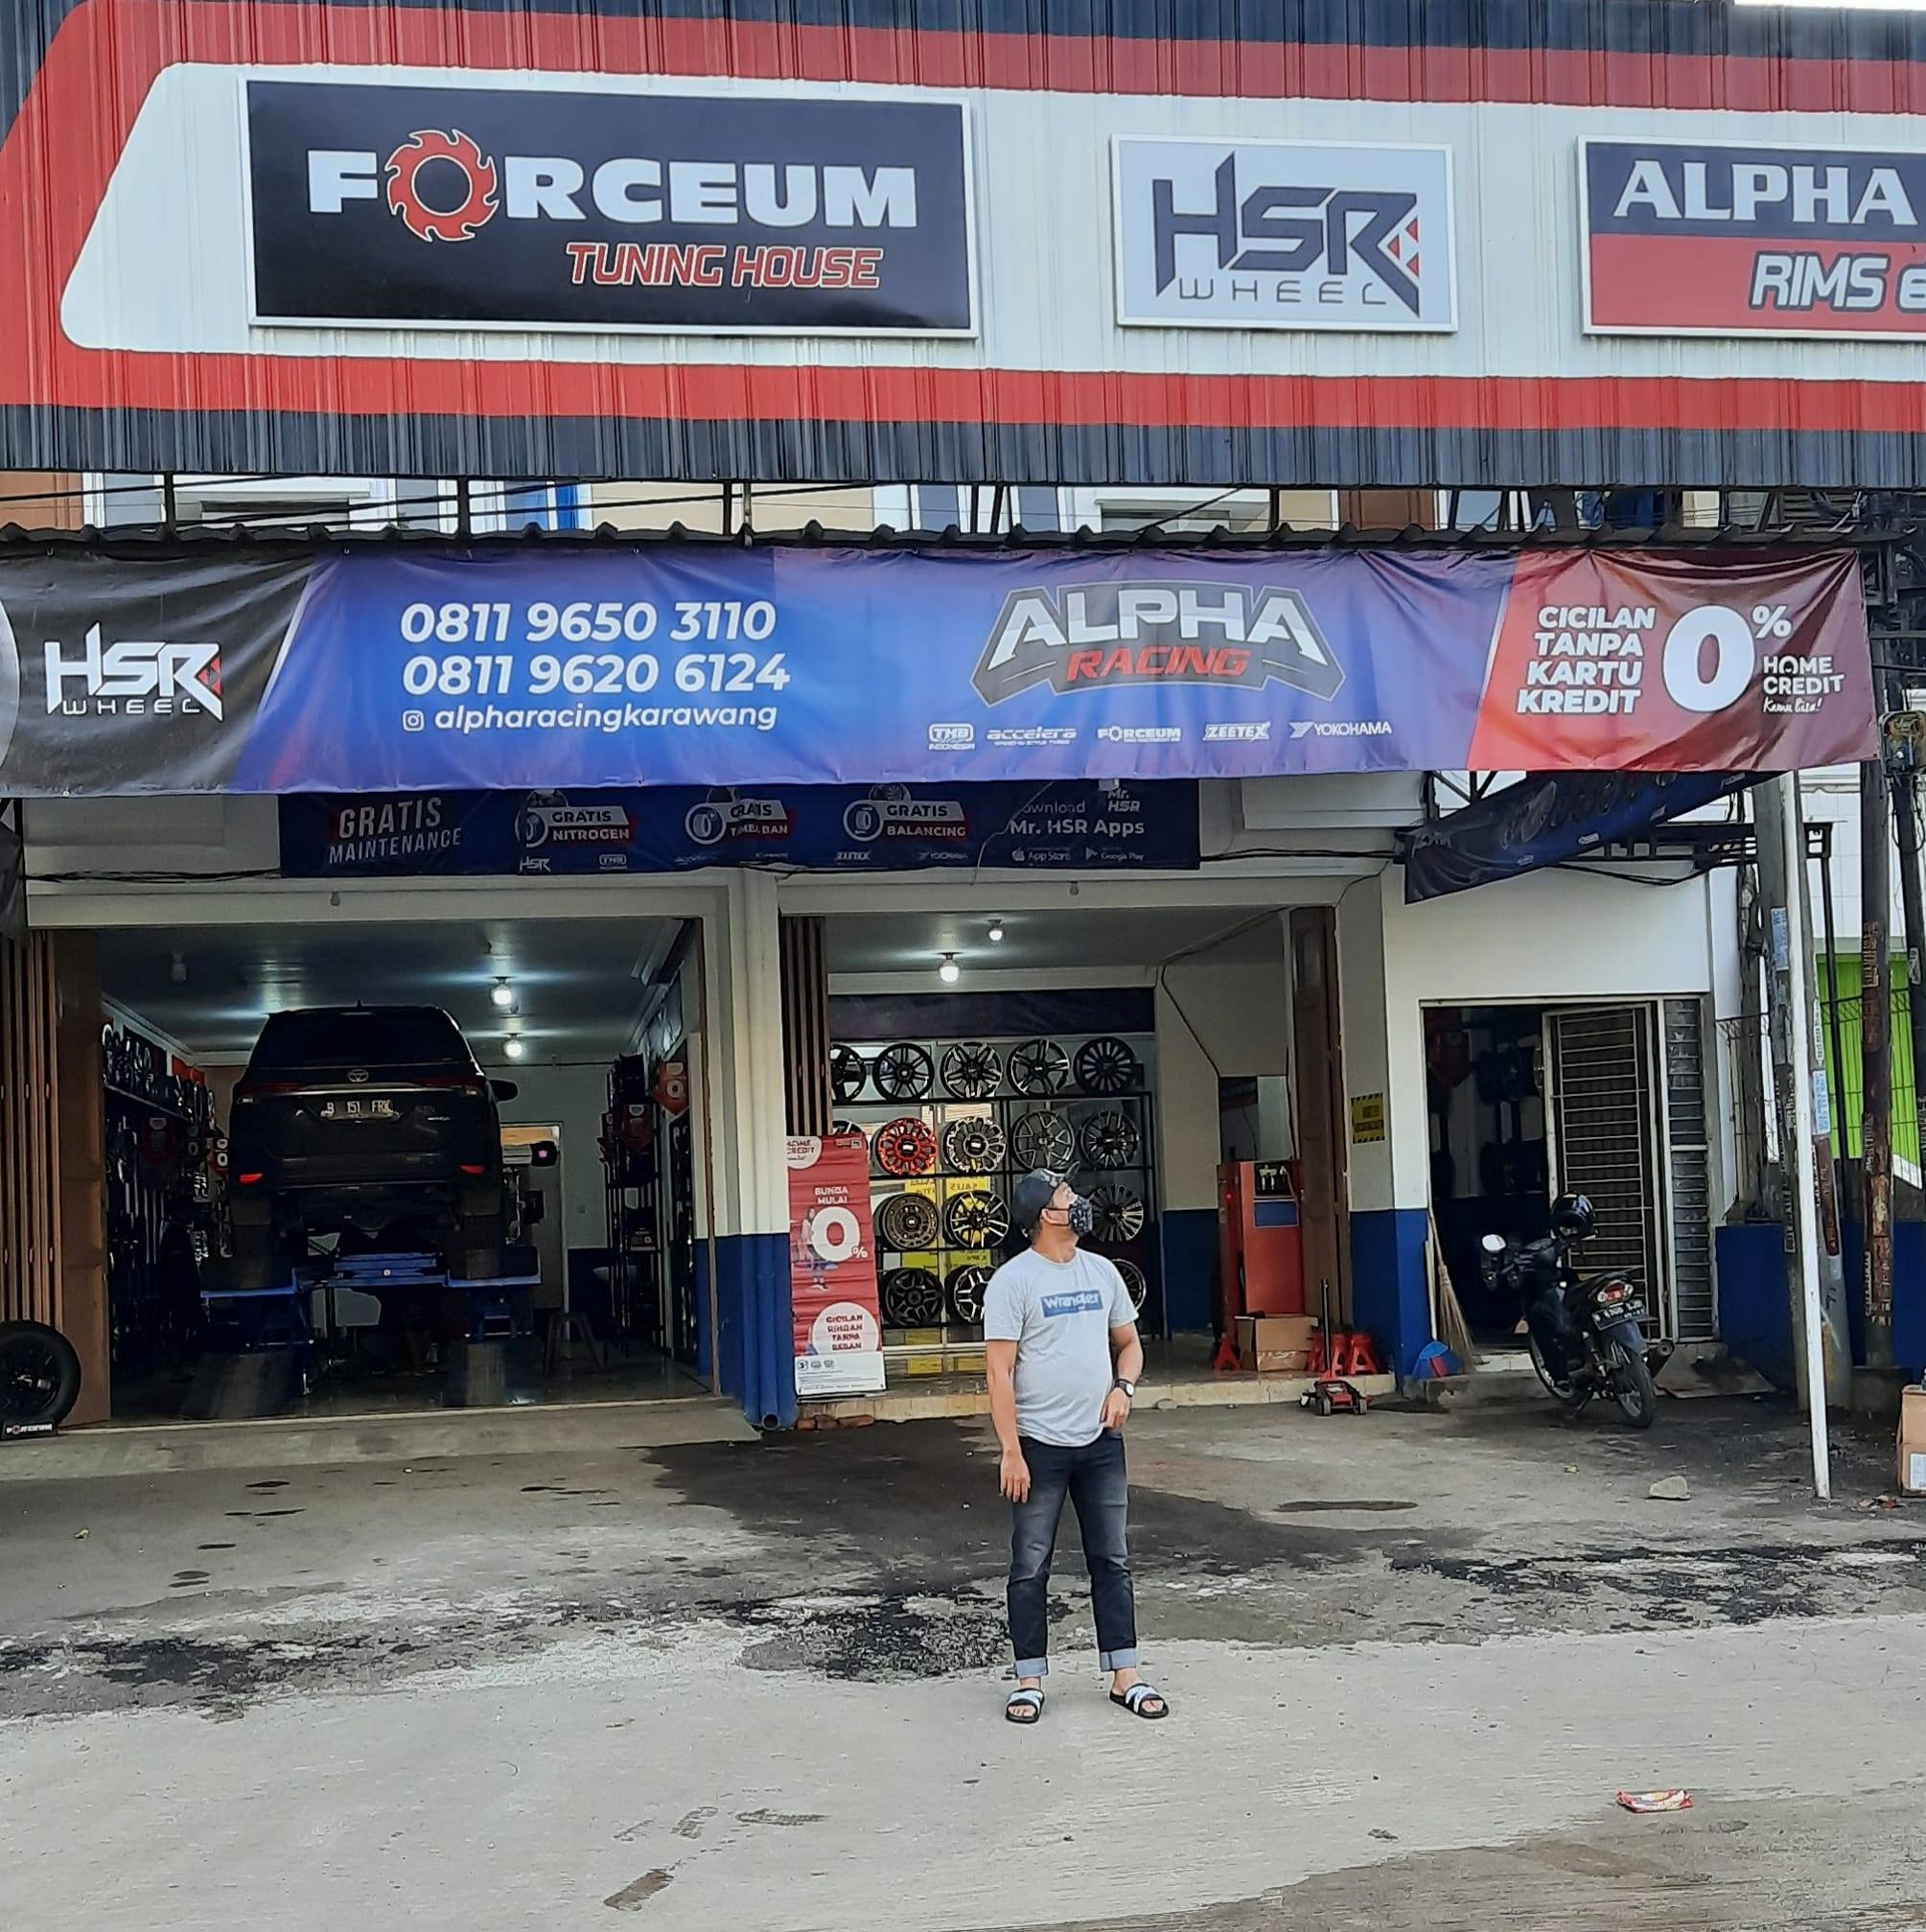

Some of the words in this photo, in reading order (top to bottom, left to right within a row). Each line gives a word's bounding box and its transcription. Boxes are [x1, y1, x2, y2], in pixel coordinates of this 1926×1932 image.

[308, 128, 918, 243] FORCEUM
[1613, 160, 1917, 225] ALPHA
[1152, 151, 1420, 318] HSR
[566, 242, 726, 287] TUNING
[731, 245, 884, 291] HOUSE
[1179, 277, 1386, 305] WHEEL
[1750, 251, 1890, 312] RIMS
[401, 602, 511, 642] 0811
[525, 601, 658, 641] 9650
[670, 600, 777, 640] 3110
[987, 589, 1328, 670] ALPHA
[1539, 606, 1656, 629] CICILAN
[1534, 632, 1643, 656] TANPA
[44, 622, 222, 721] HSR
[403, 655, 514, 695] 0811
[528, 654, 659, 694] 9620
[674, 652, 790, 692] 6124
[1066, 645, 1252, 682] RACING
[1527, 661, 1643, 686] KARTU
[1763, 655, 1834, 674] HOME
[1763, 674, 1845, 695] CREDIT
[62, 698, 200, 714] WHEEL
[1517, 689, 1642, 713] KREDIT
[434, 703, 777, 734] alpharacingkarawang
[1314, 721, 1392, 736] YOKOHAMA
[986, 726, 1078, 740] accelera
[1097, 725, 1182, 741] FORCEUM
[338, 797, 442, 839] GRATIS
[551, 810, 612, 824] GRATIS
[887, 804, 948, 817] GRATIS
[1020, 800, 1086, 814] ownload
[552, 828, 630, 841] NITROGEN
[887, 826, 966, 837] BALANCING
[1009, 820, 1042, 835] Mr.
[1047, 819, 1088, 834] HSR
[1093, 819, 1146, 838] Apps
[329, 827, 462, 864] MAINTENANCE
[814, 1186, 849, 1196] BUNGA
